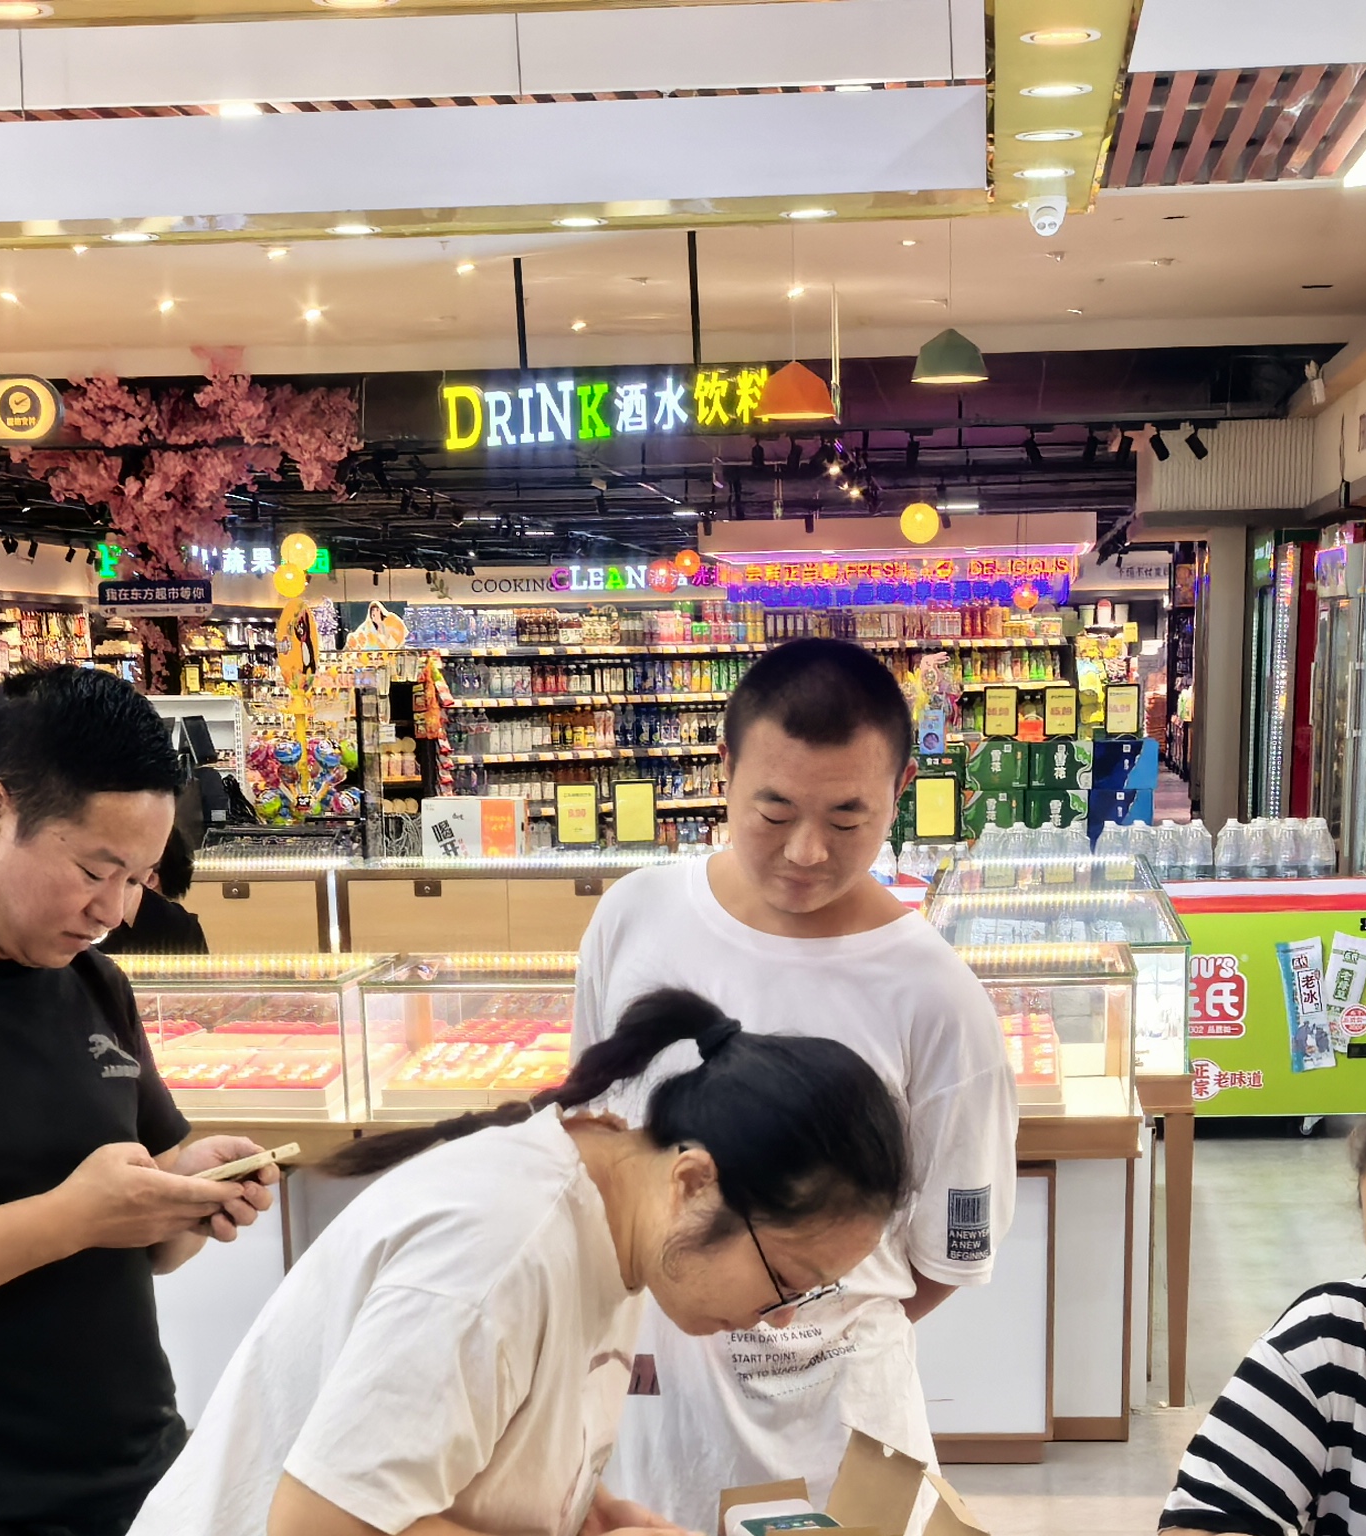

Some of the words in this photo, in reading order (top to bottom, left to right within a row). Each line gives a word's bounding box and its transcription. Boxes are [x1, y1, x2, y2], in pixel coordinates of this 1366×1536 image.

[443, 380, 612, 450] DRINK
[222, 547, 330, 575] 蔬果园
[551, 564, 648, 592] CLEAN
[1193, 1063, 1210, 1097] 正宗
[1213, 1070, 1263, 1088] 老味道
[959, 1240, 981, 1250] NEW
[758, 1333, 778, 1344] DAY
[798, 1327, 823, 1340] NEW
[732, 1353, 762, 1364] START
[765, 1352, 796, 1363] POINT
